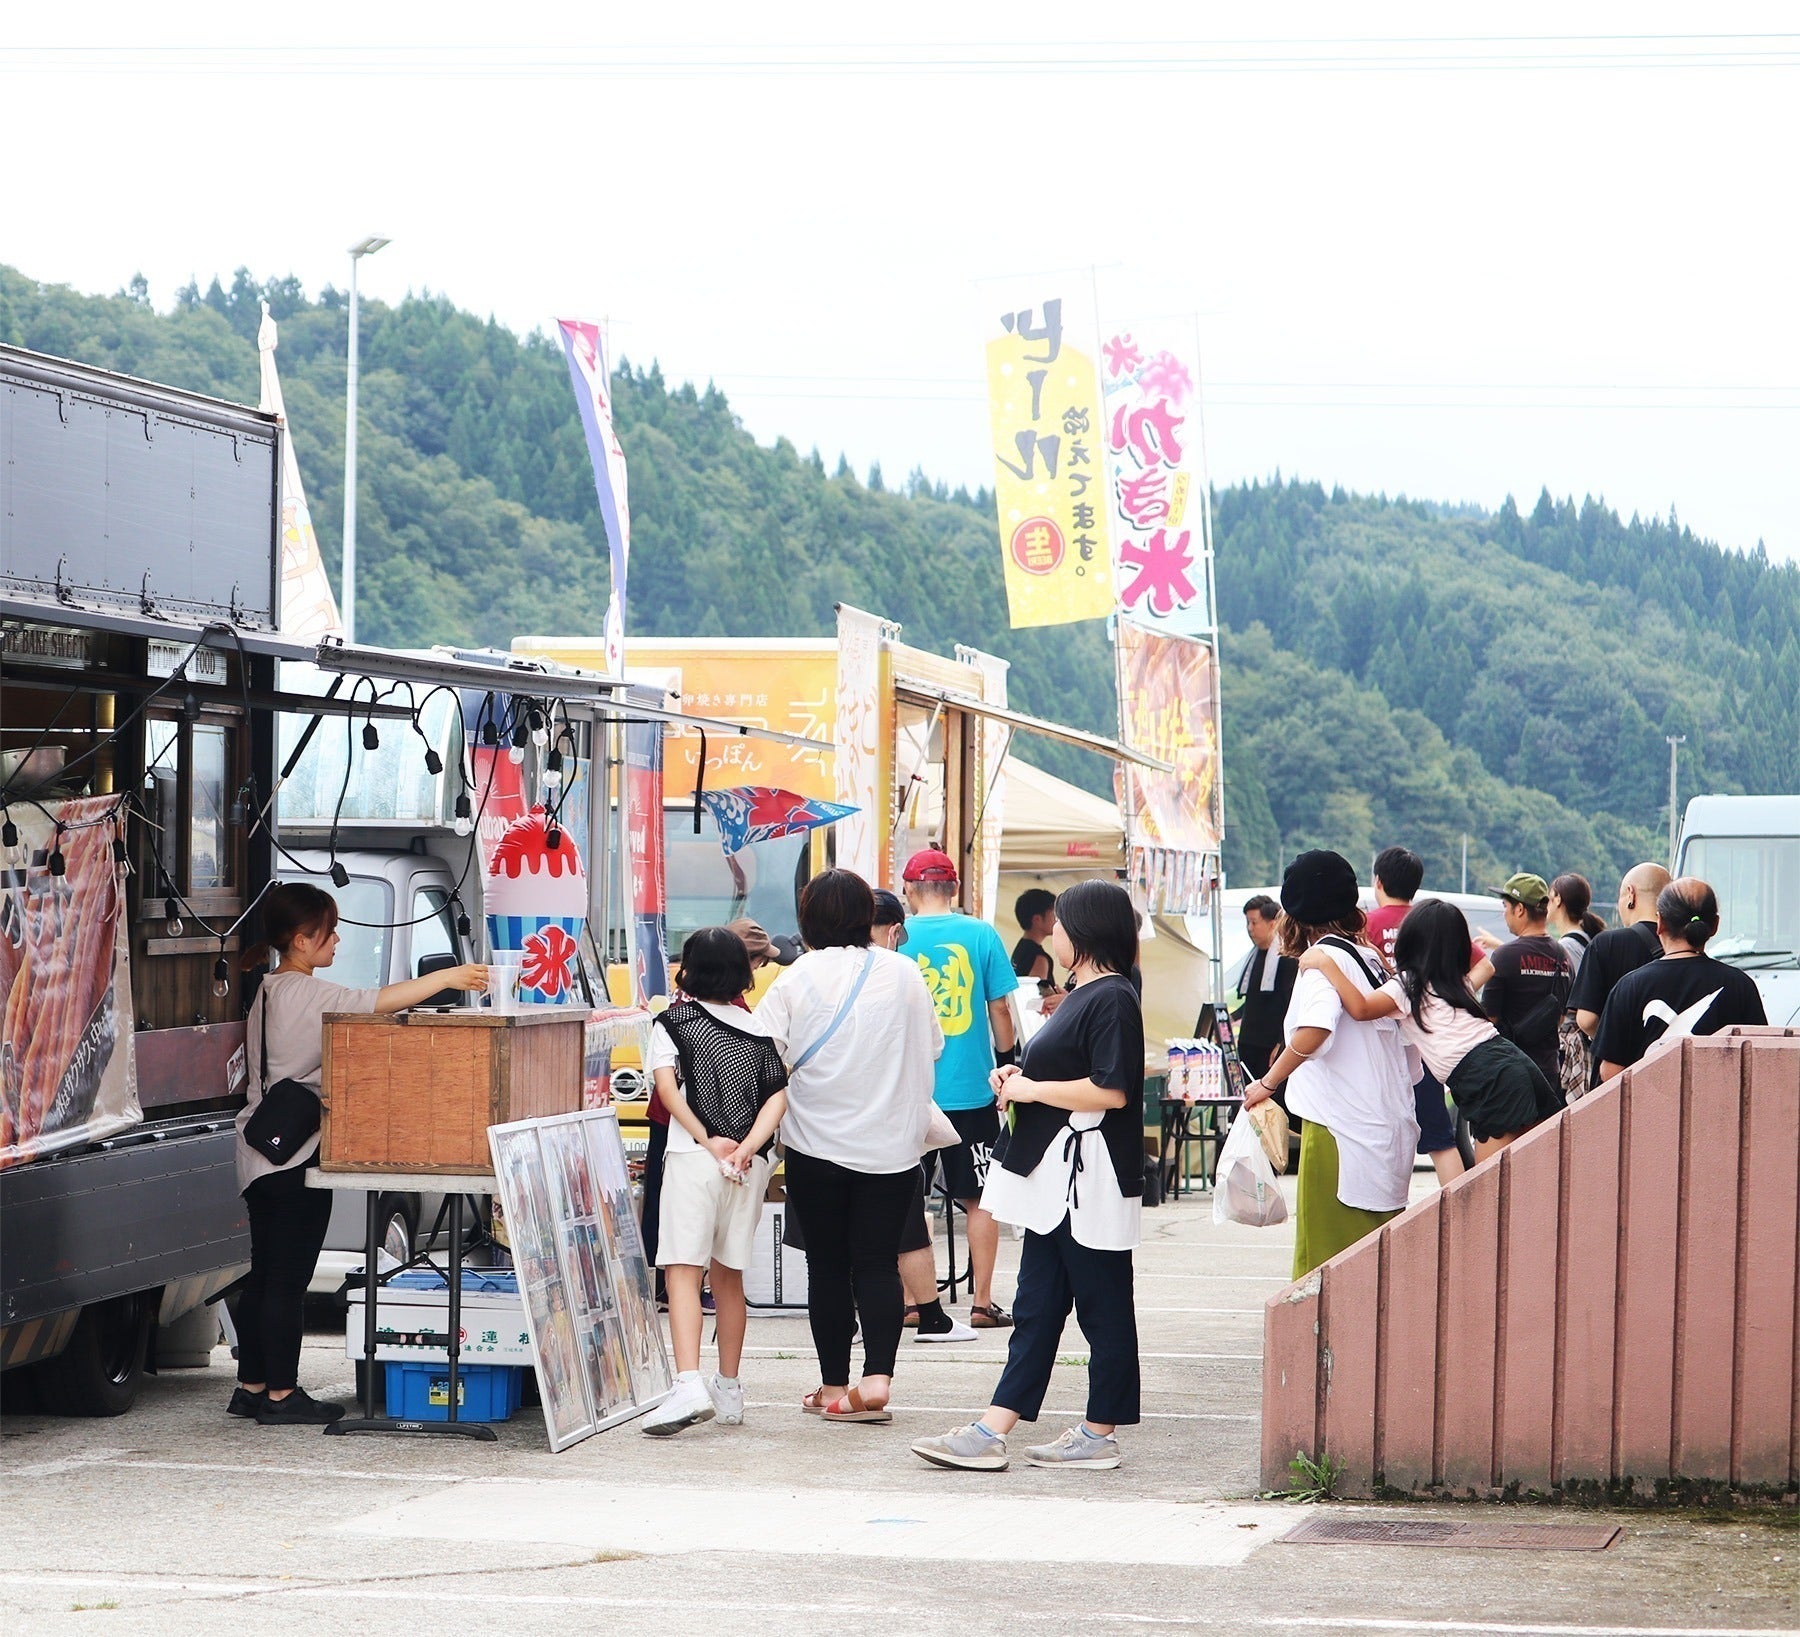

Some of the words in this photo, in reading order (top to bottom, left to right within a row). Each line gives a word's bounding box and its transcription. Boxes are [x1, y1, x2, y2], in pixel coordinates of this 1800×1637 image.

[22, 629, 48, 655] BAKE
[195, 650, 216, 675] FOOD
[682, 693, 769, 708] 卵焼き専門店
[684, 742, 762, 772] いっぽん
[520, 925, 577, 998] 氷
